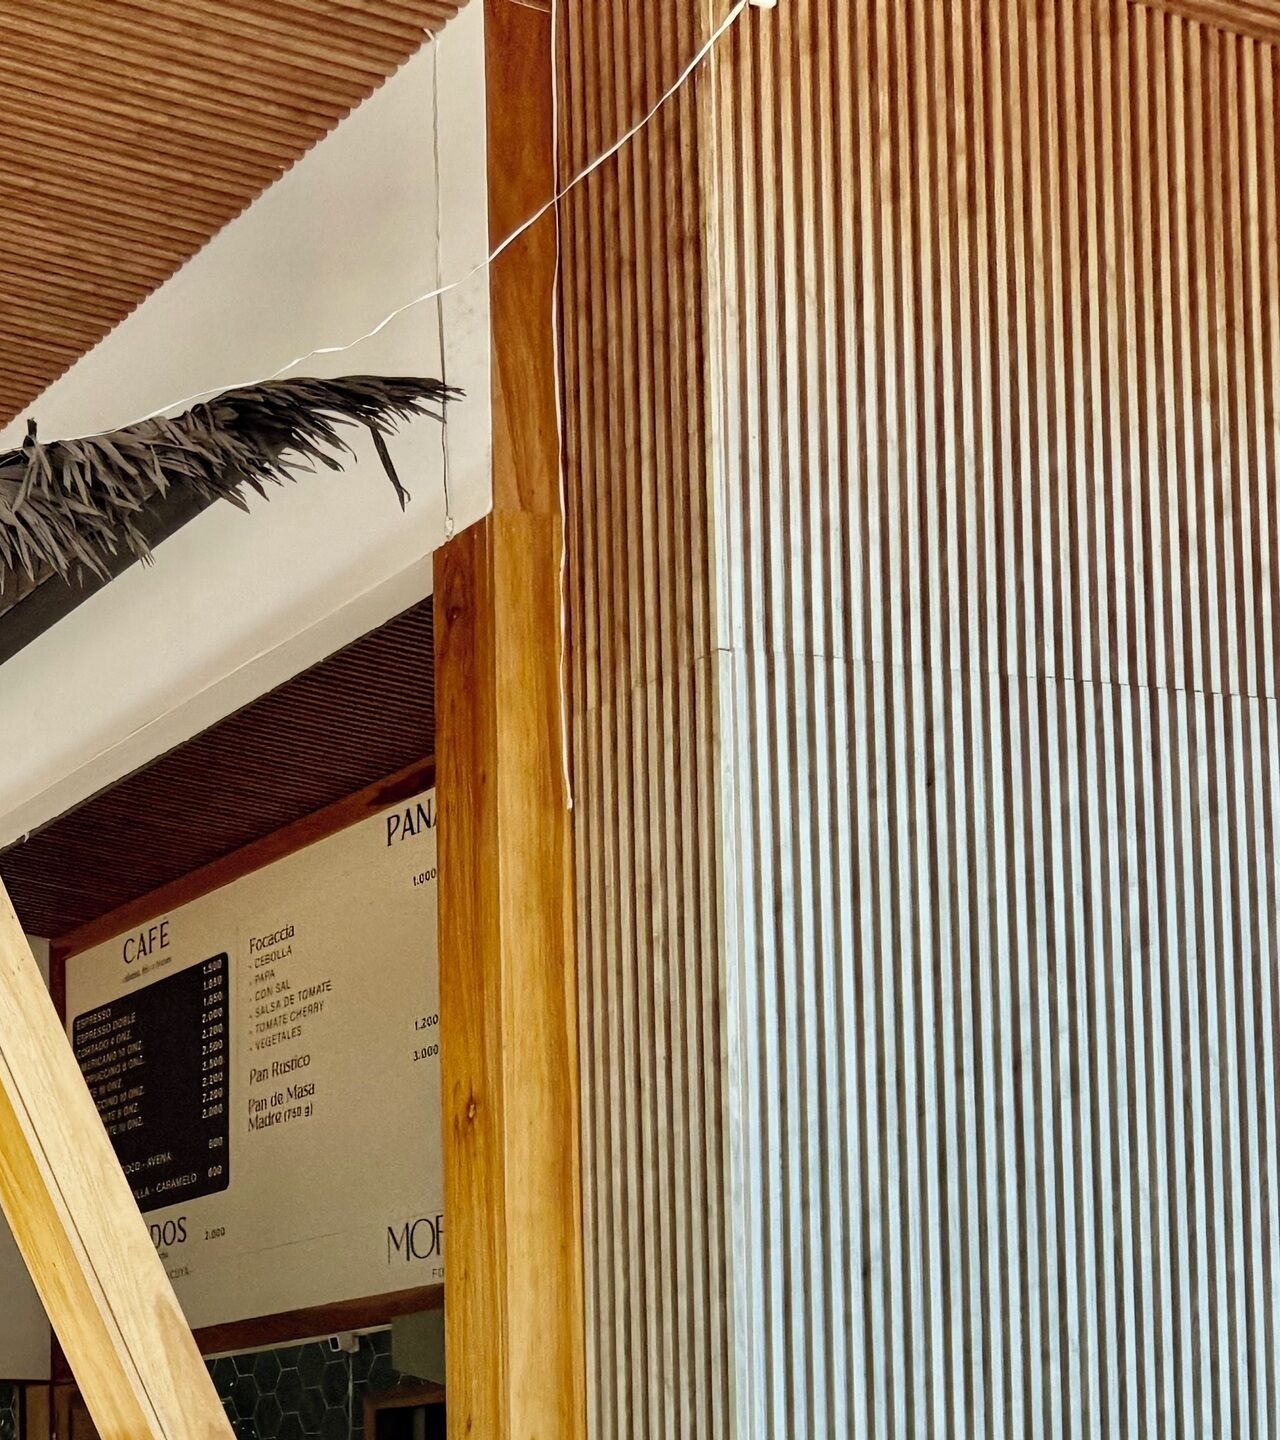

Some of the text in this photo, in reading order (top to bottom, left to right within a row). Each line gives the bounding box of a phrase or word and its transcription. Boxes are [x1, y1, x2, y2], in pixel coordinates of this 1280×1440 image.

[249, 924, 295, 955] Focaccia
[254, 945, 292, 969] CEBOLLA
[255, 979, 291, 1001] CON SAL
[255, 979, 333, 1018] SALSA DE TOMATE
[76, 1023, 112, 1045] ESPRESSO
[255, 1013, 289, 1033] TOMATE
[255, 1025, 302, 1050] VEGETALES
[249, 1068, 269, 1086] Pan
[248, 1083, 315, 1116] Pan de Masa
[248, 1110, 282, 1132] Madre
[155, 1173, 197, 1192] CARAMELO
